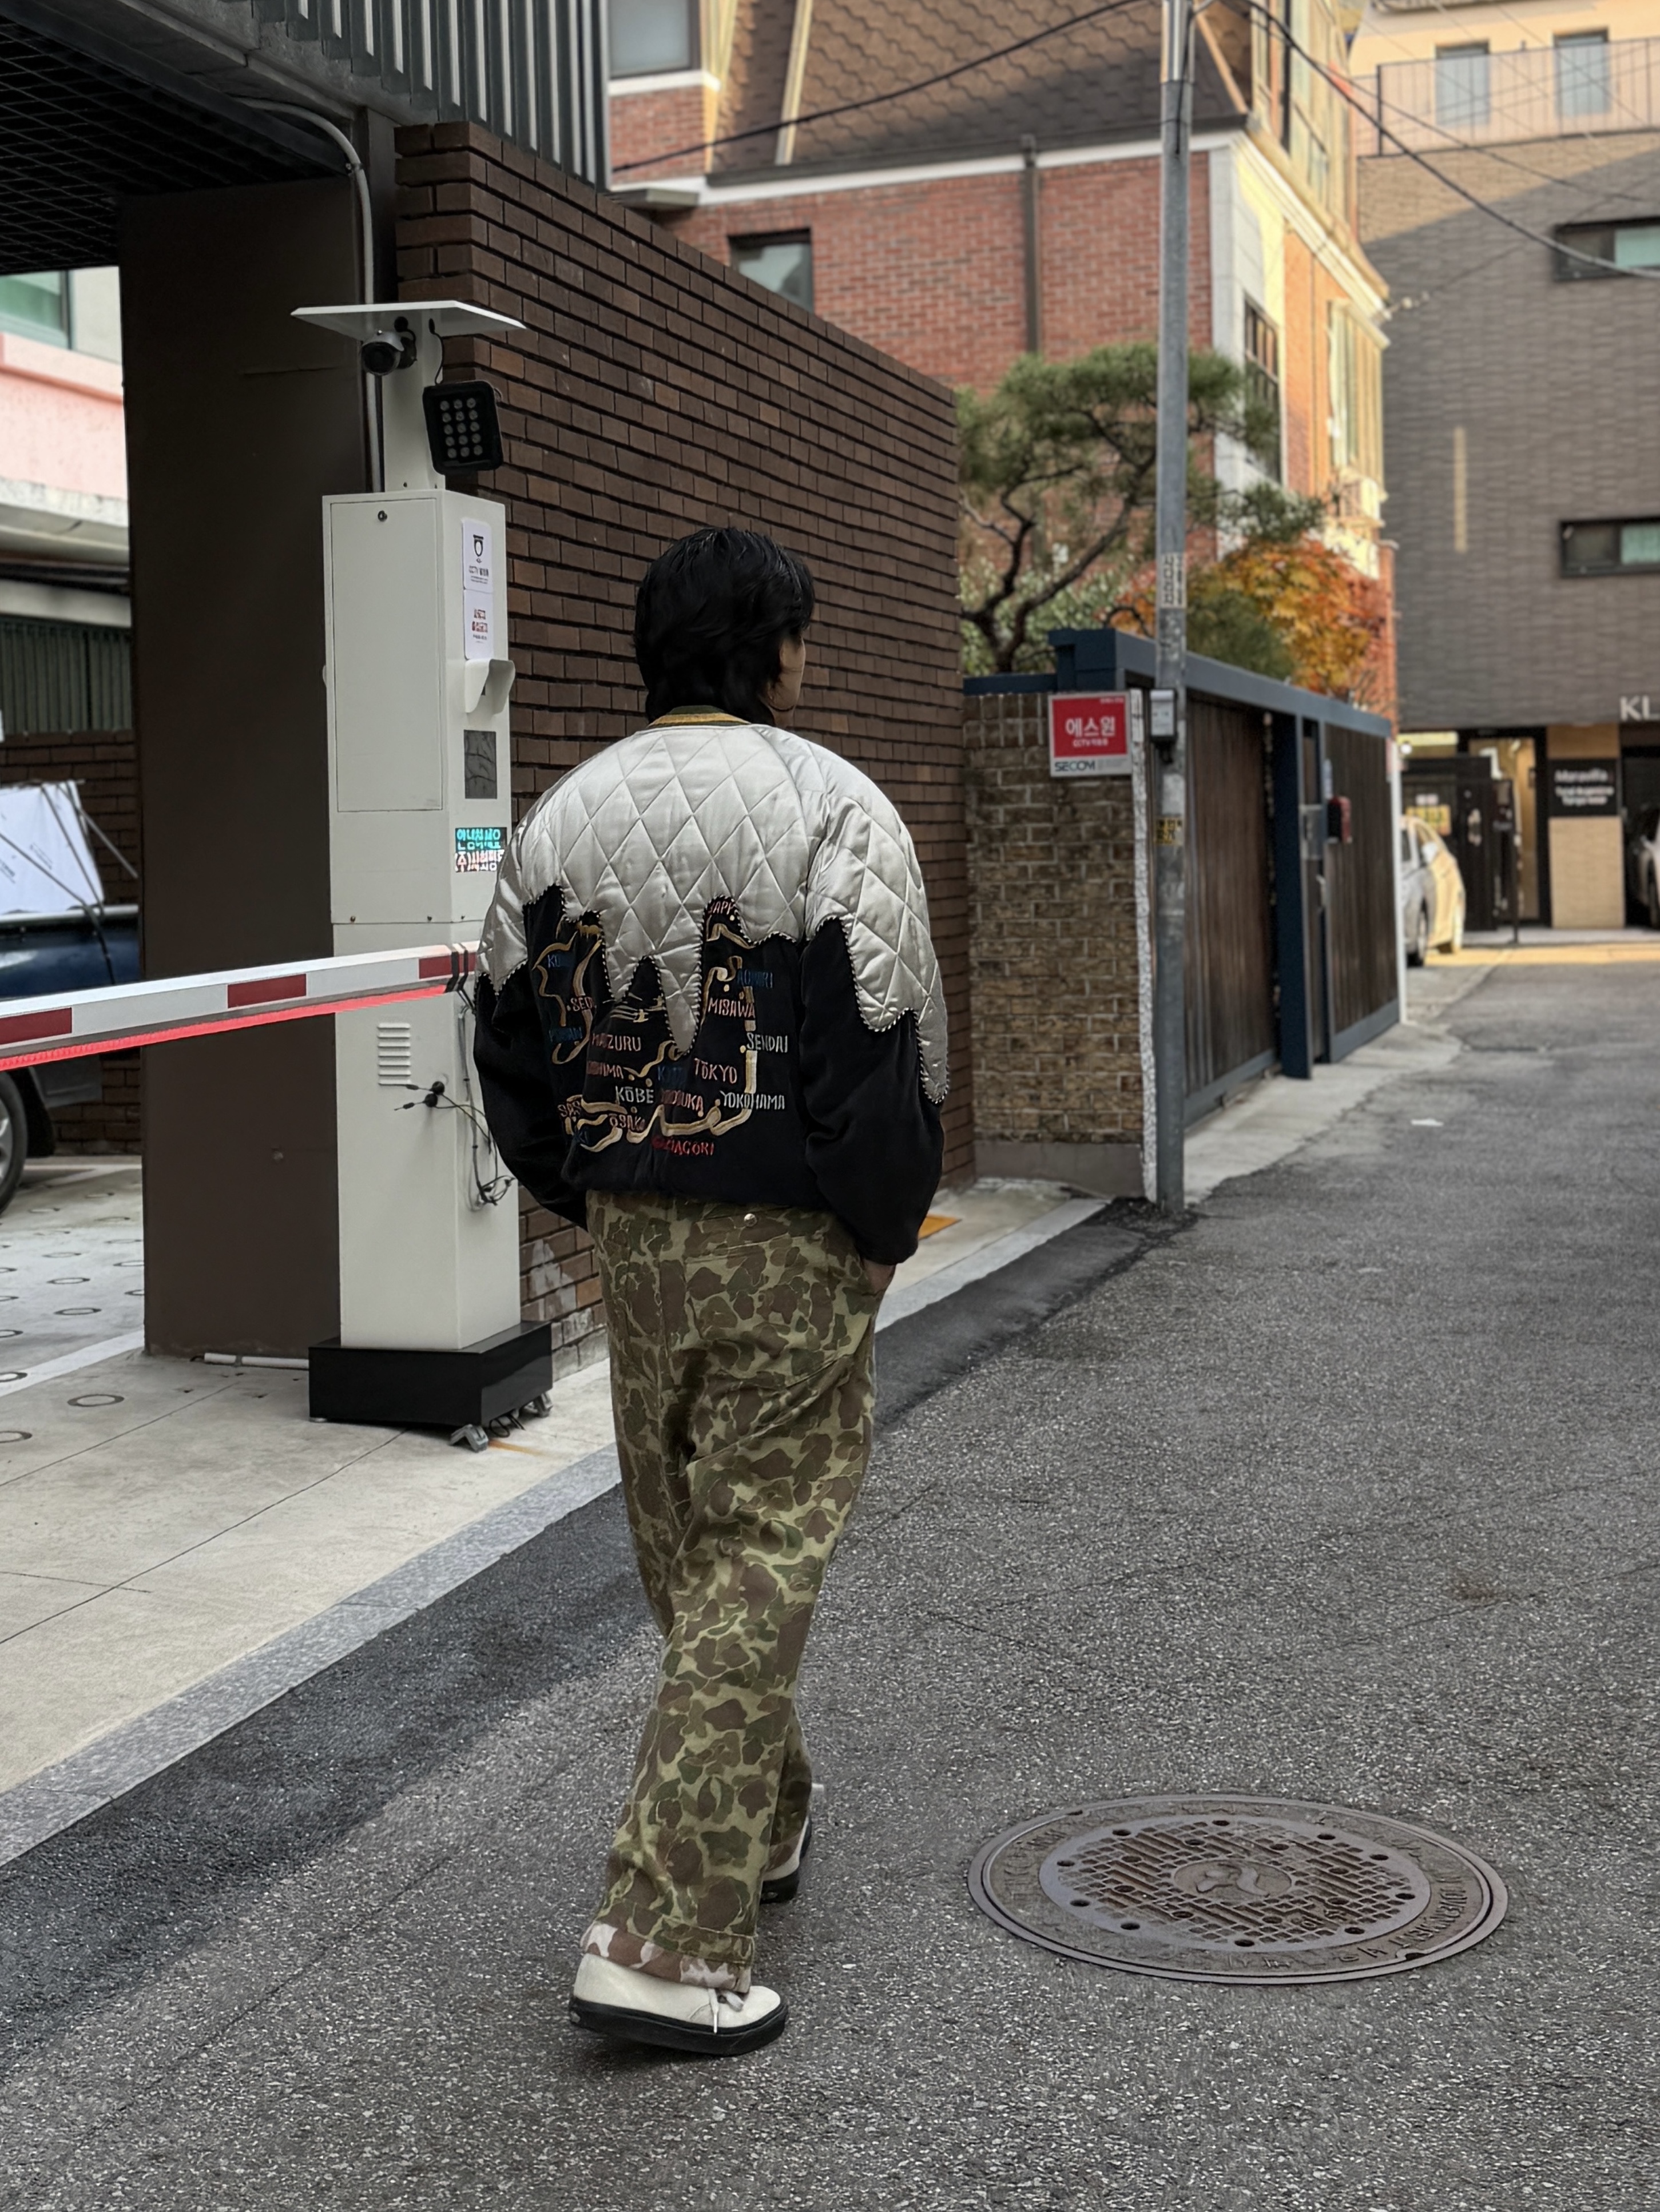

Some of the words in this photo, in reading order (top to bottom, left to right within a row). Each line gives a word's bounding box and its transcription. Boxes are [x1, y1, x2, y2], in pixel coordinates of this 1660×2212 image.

[1065, 715, 1115, 738] 에스원
[1054, 760, 1095, 772] SECOM
[708, 997, 756, 1018] MISAWA
[746, 1032, 788, 1053] SENDAI
[720, 1090, 785, 1110] YOKOHAMA
